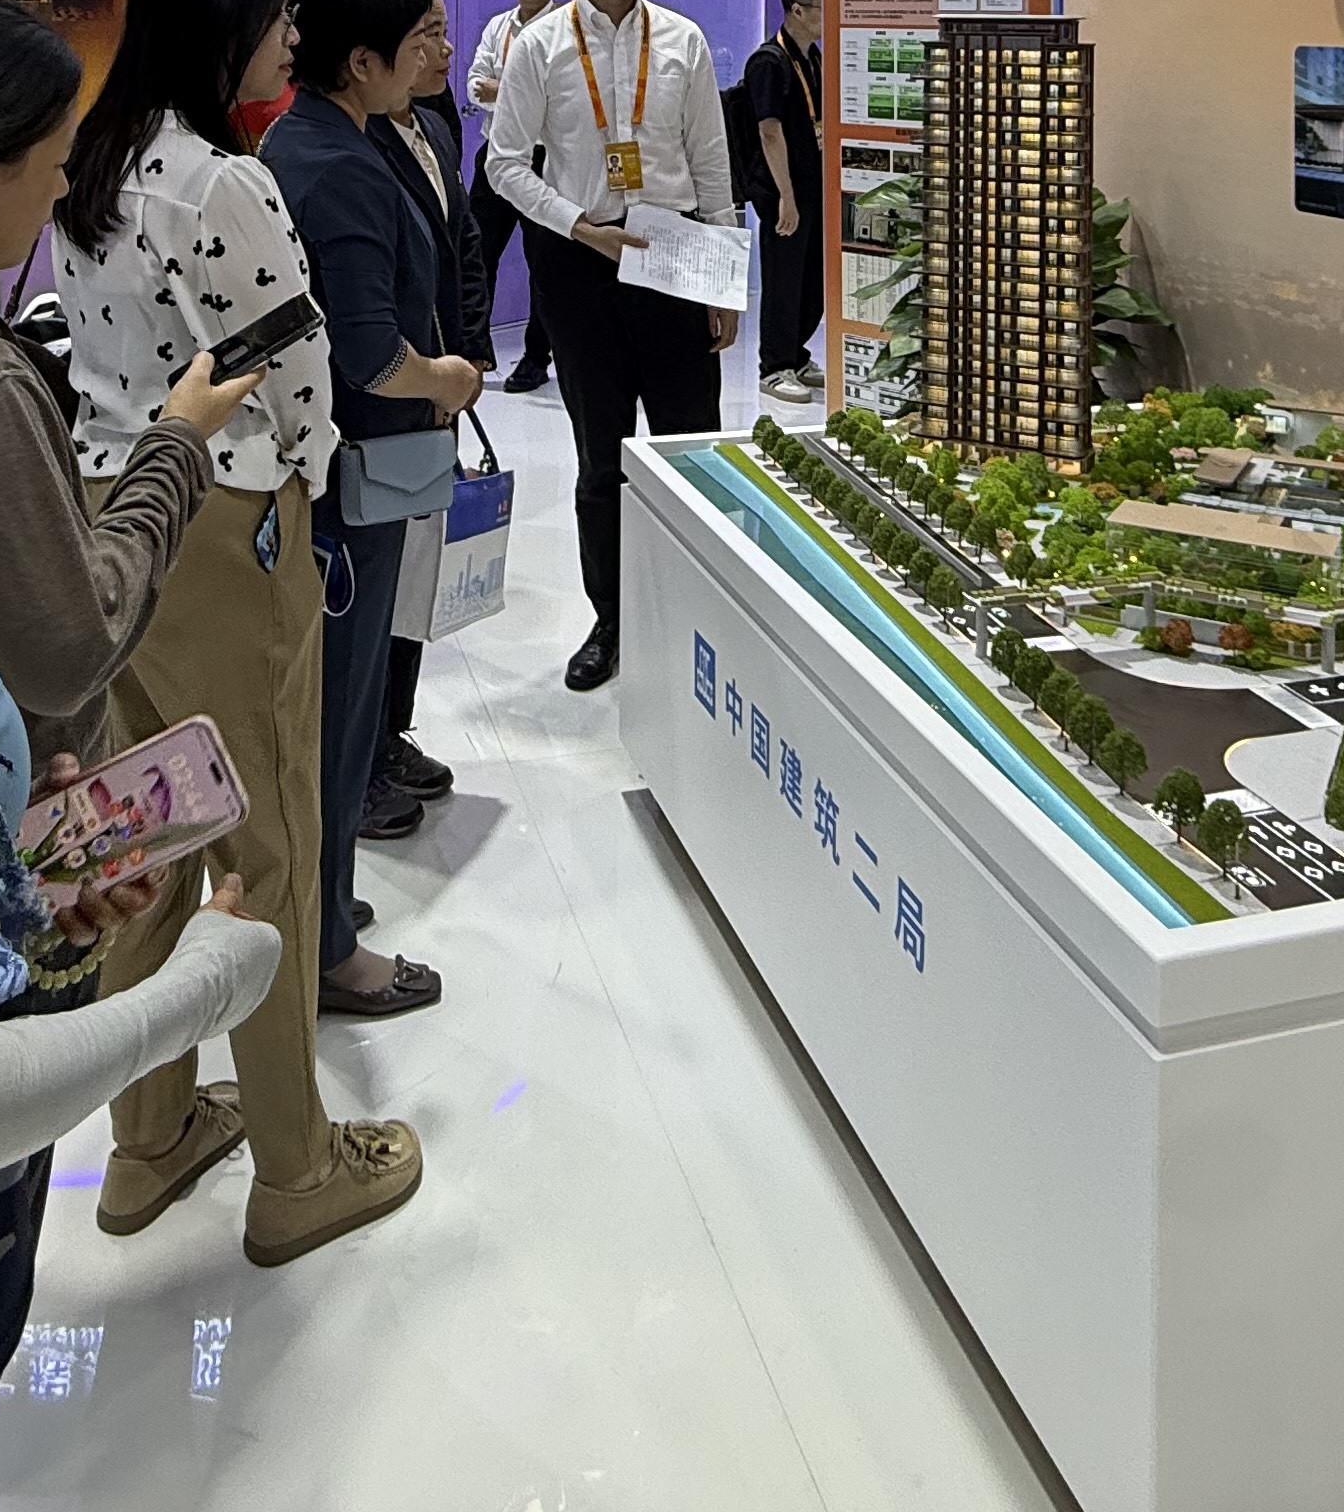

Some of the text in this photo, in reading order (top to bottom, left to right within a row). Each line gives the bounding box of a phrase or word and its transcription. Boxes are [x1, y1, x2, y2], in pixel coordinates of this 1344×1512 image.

[725, 678, 926, 975] 中国建筑二局
